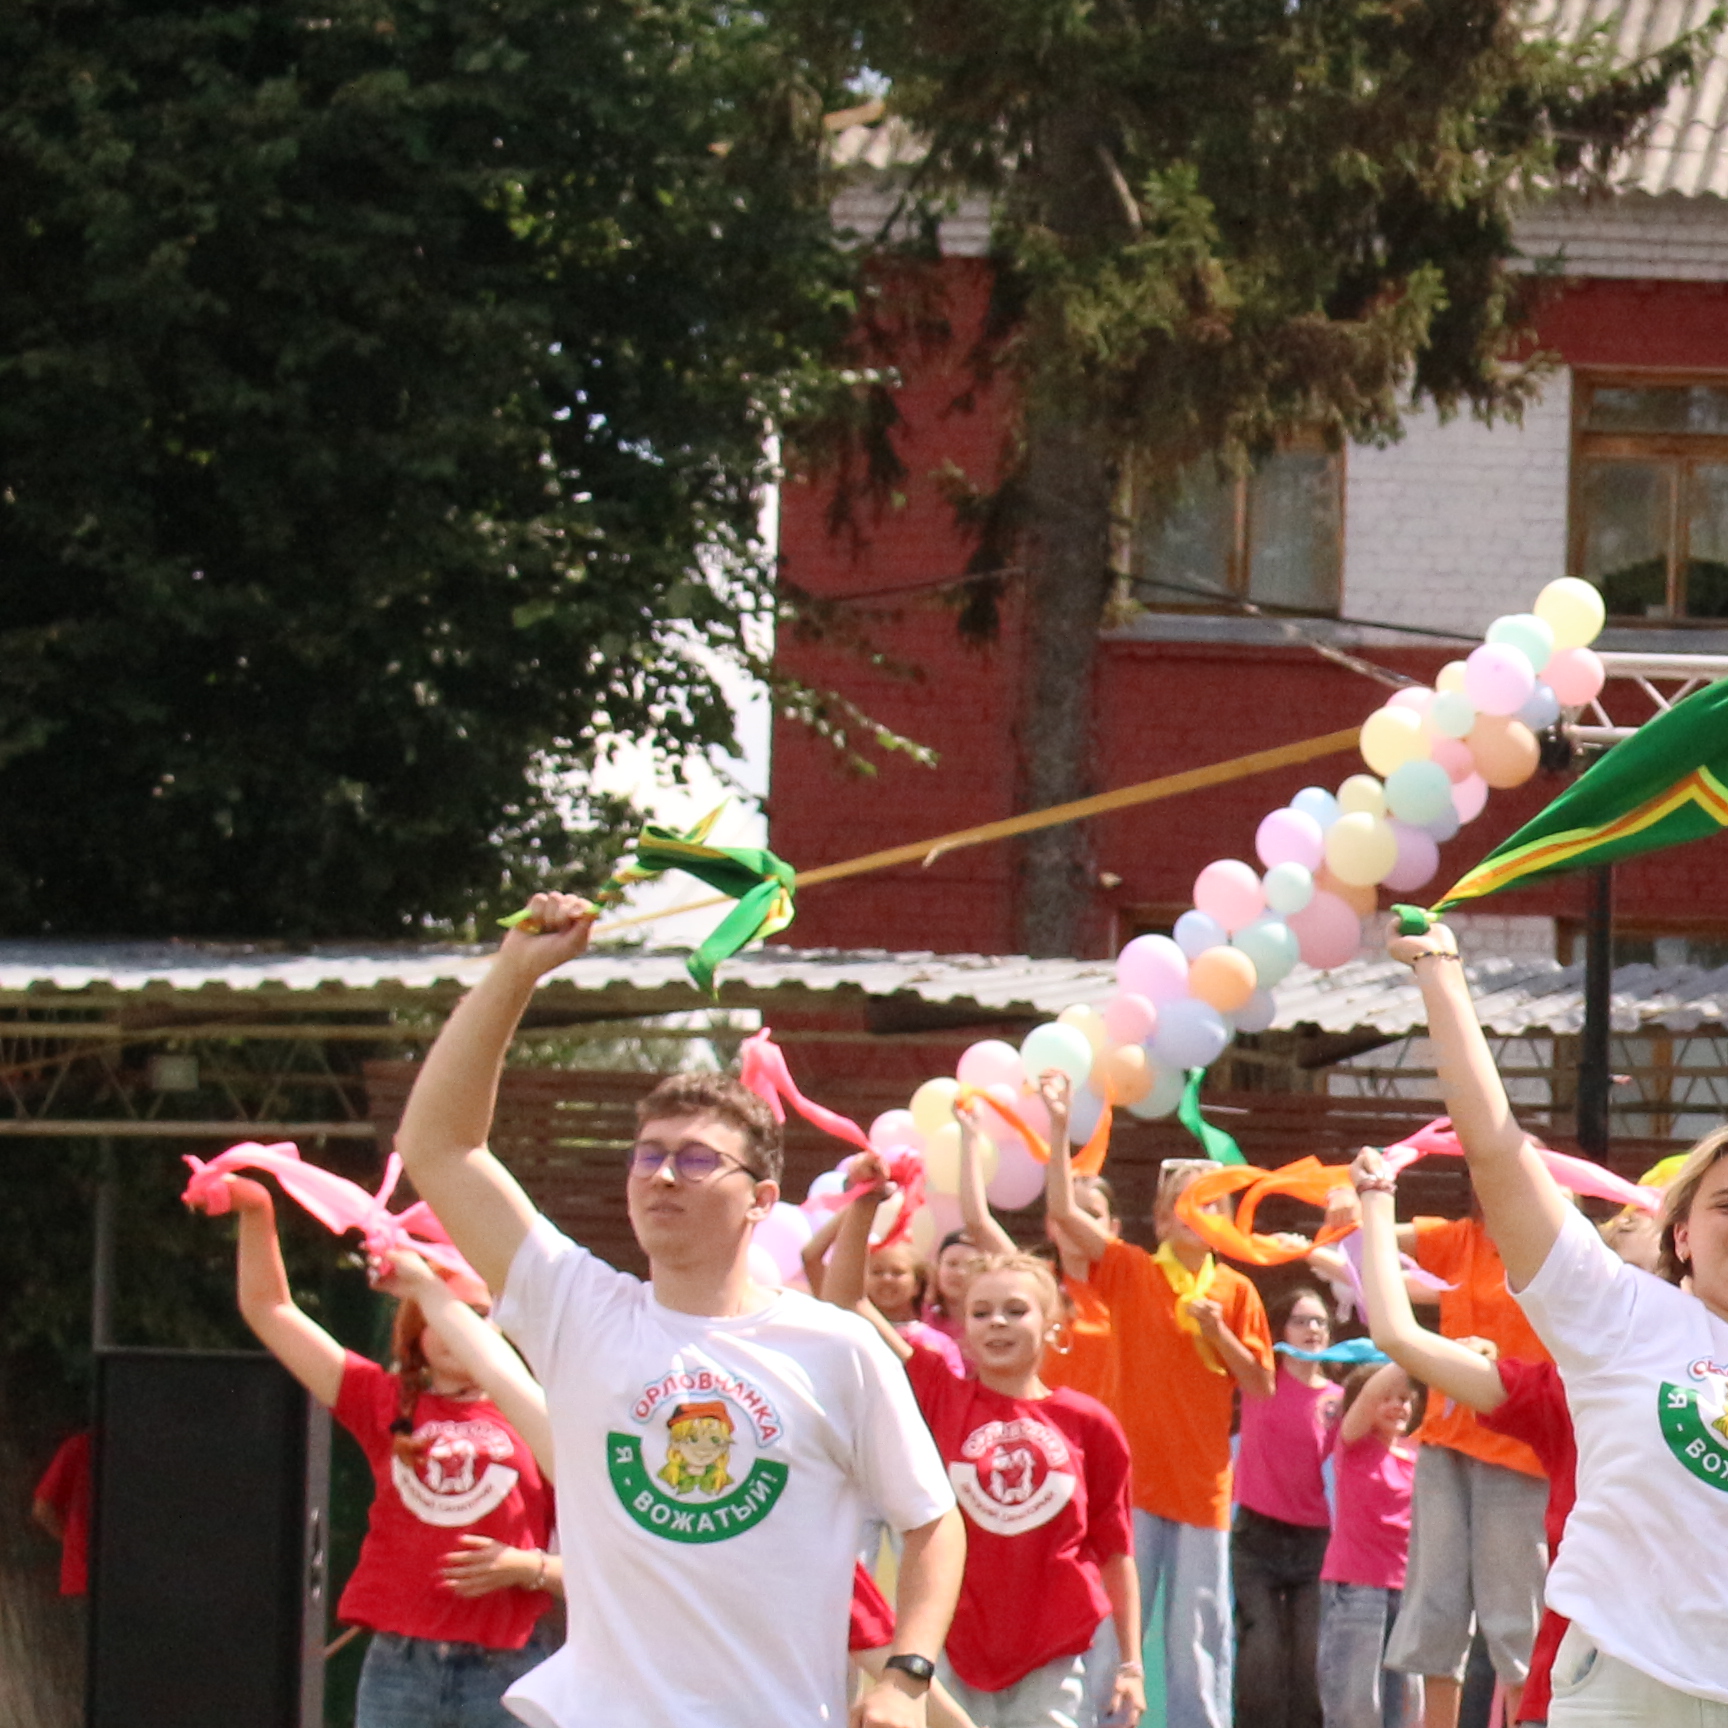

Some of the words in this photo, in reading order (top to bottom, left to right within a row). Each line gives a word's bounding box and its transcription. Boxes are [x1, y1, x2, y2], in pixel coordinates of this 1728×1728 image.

[635, 1371, 778, 1441] ОРЛОВЧАНКА
[1667, 1392, 1688, 1409] Я
[615, 1446, 633, 1463] Я
[633, 1472, 778, 1532] ВОЖАТЫЙ!
